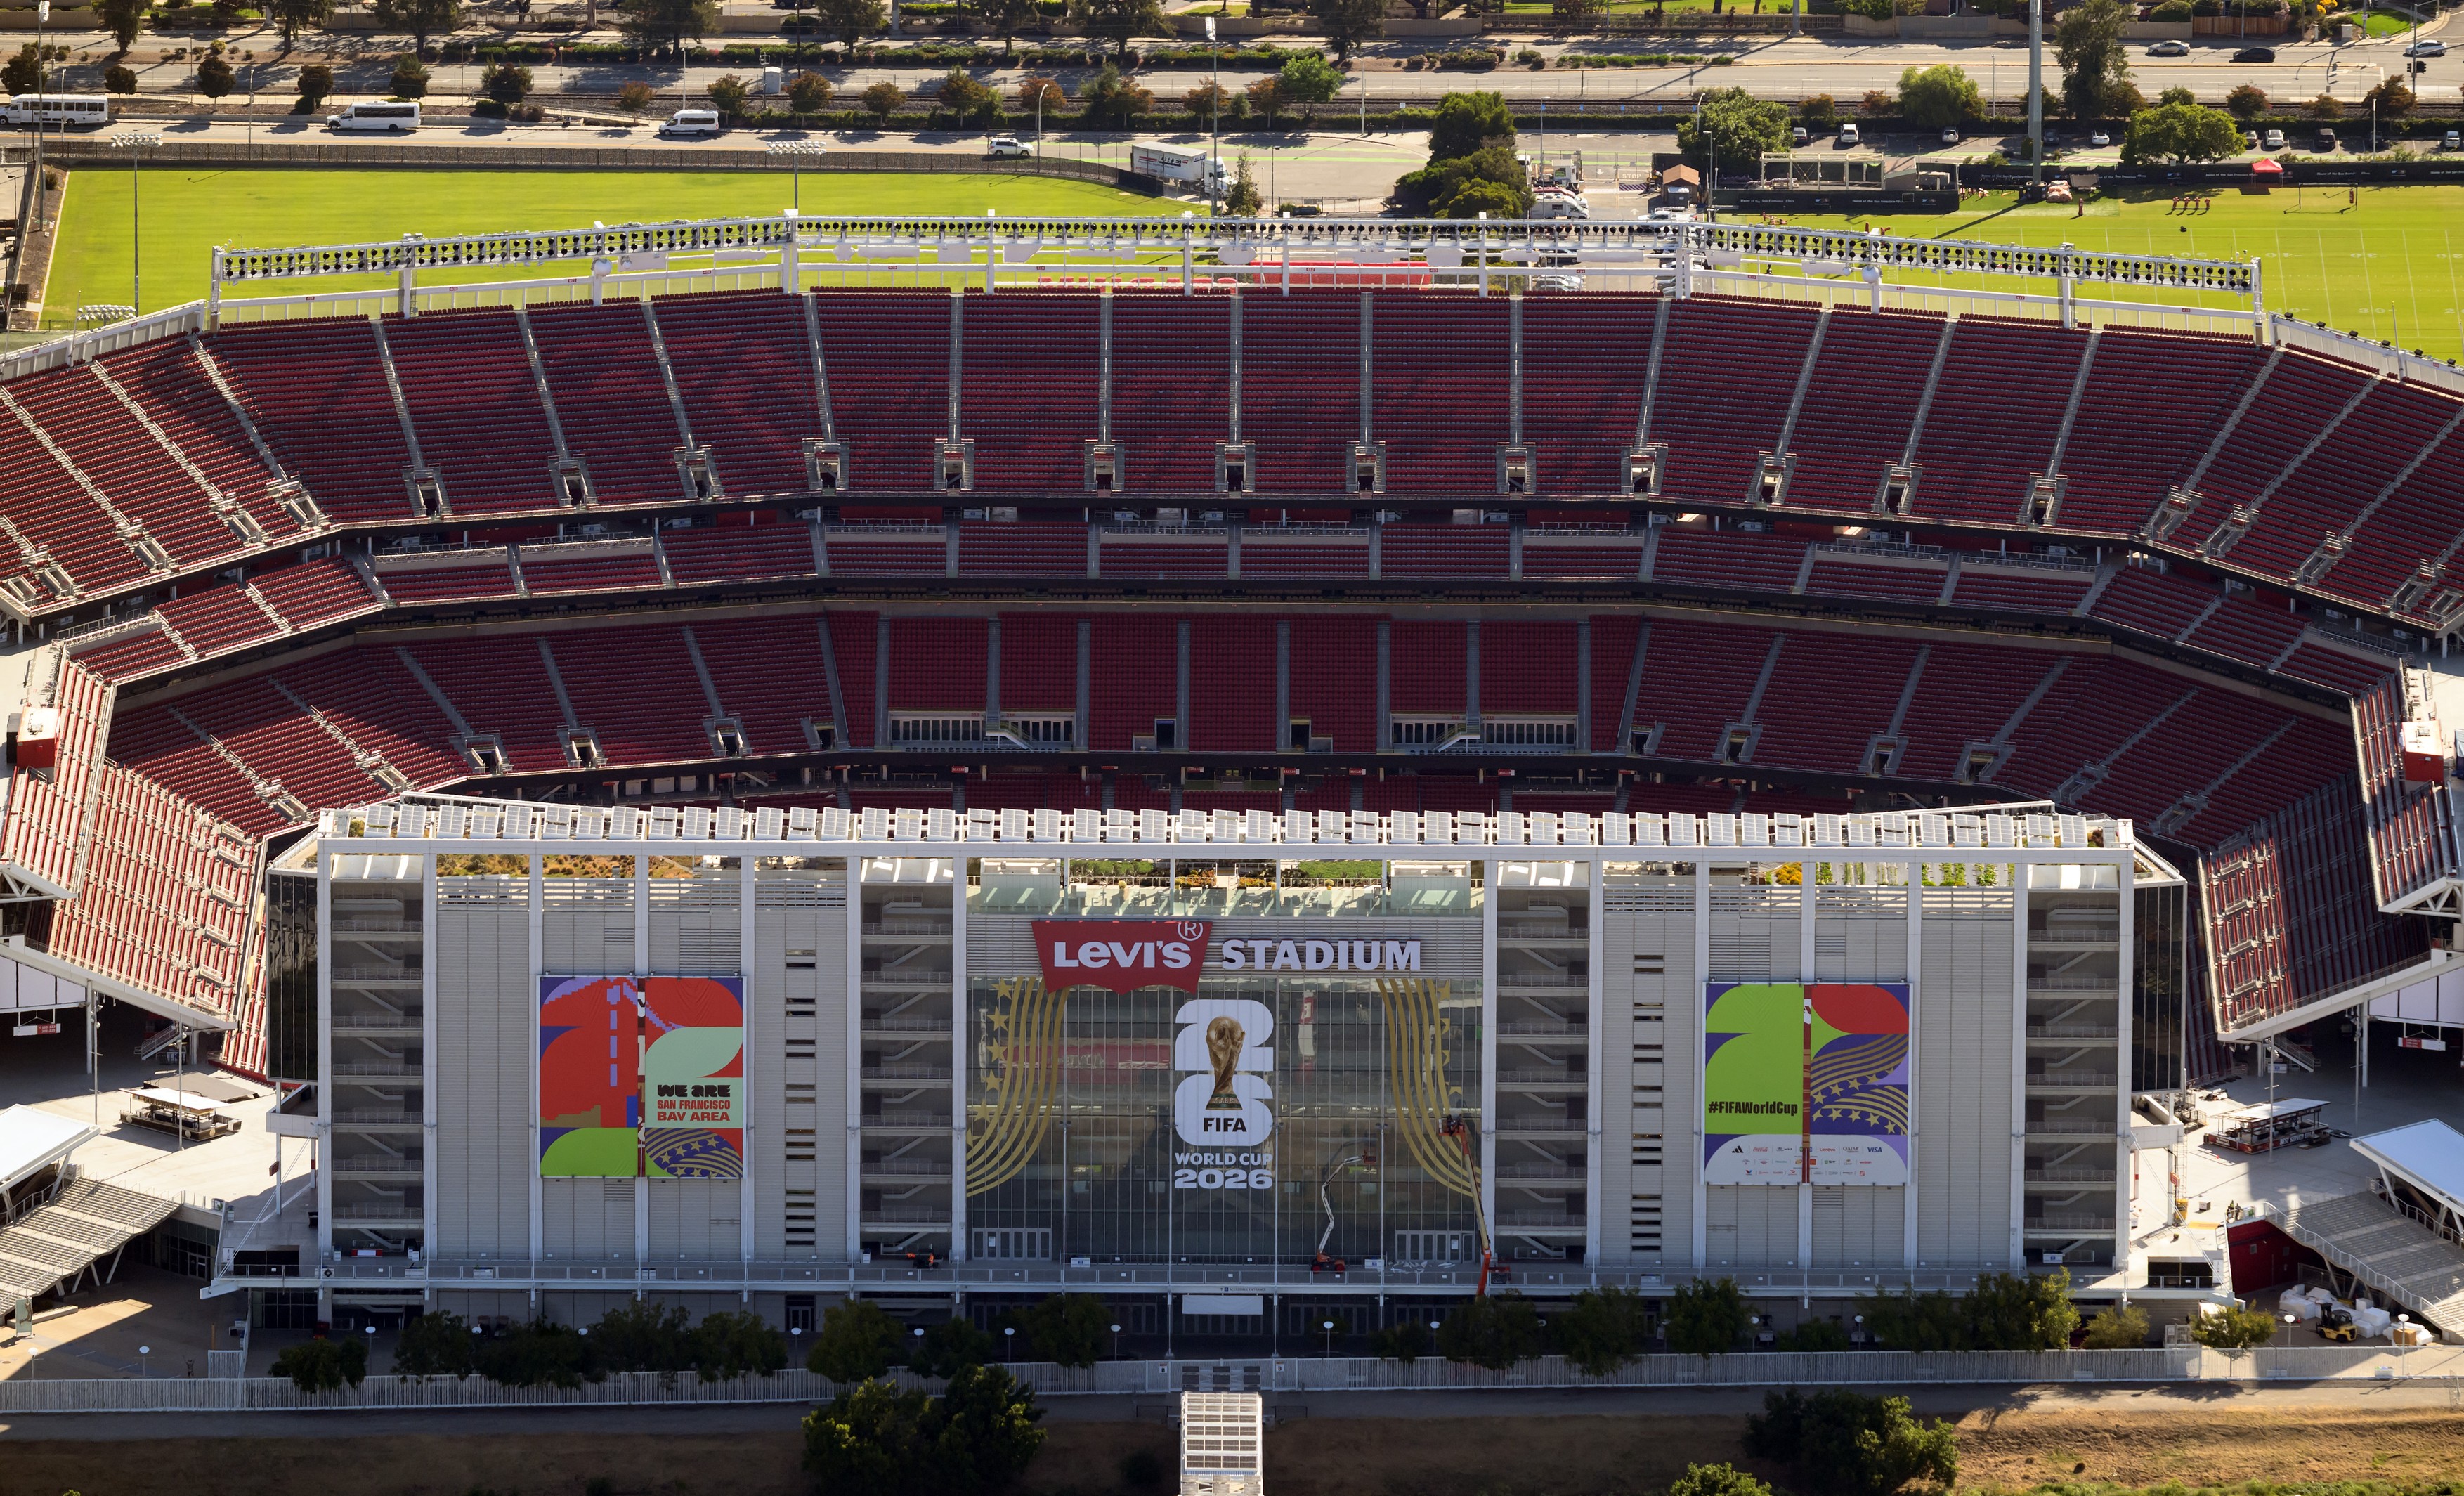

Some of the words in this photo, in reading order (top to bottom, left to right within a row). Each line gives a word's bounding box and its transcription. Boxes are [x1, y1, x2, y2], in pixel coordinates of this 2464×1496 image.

[1222, 939, 1421, 970] STADIUM
[658, 1084, 688, 1097] WE
[691, 1085, 731, 1097] ARE
[657, 1100, 676, 1110] SAN
[679, 1100, 730, 1110] FRANCISCO
[1708, 1101, 1798, 1117] #FIFAWorldCup
[658, 1112, 686, 1121] BAY
[690, 1112, 730, 1121] AREA
[1204, 1117, 1247, 1132] FIFA
[1175, 1152, 1237, 1165] WORLD
[1239, 1152, 1273, 1165] CUP
[1174, 1169, 1273, 1189] 2026
